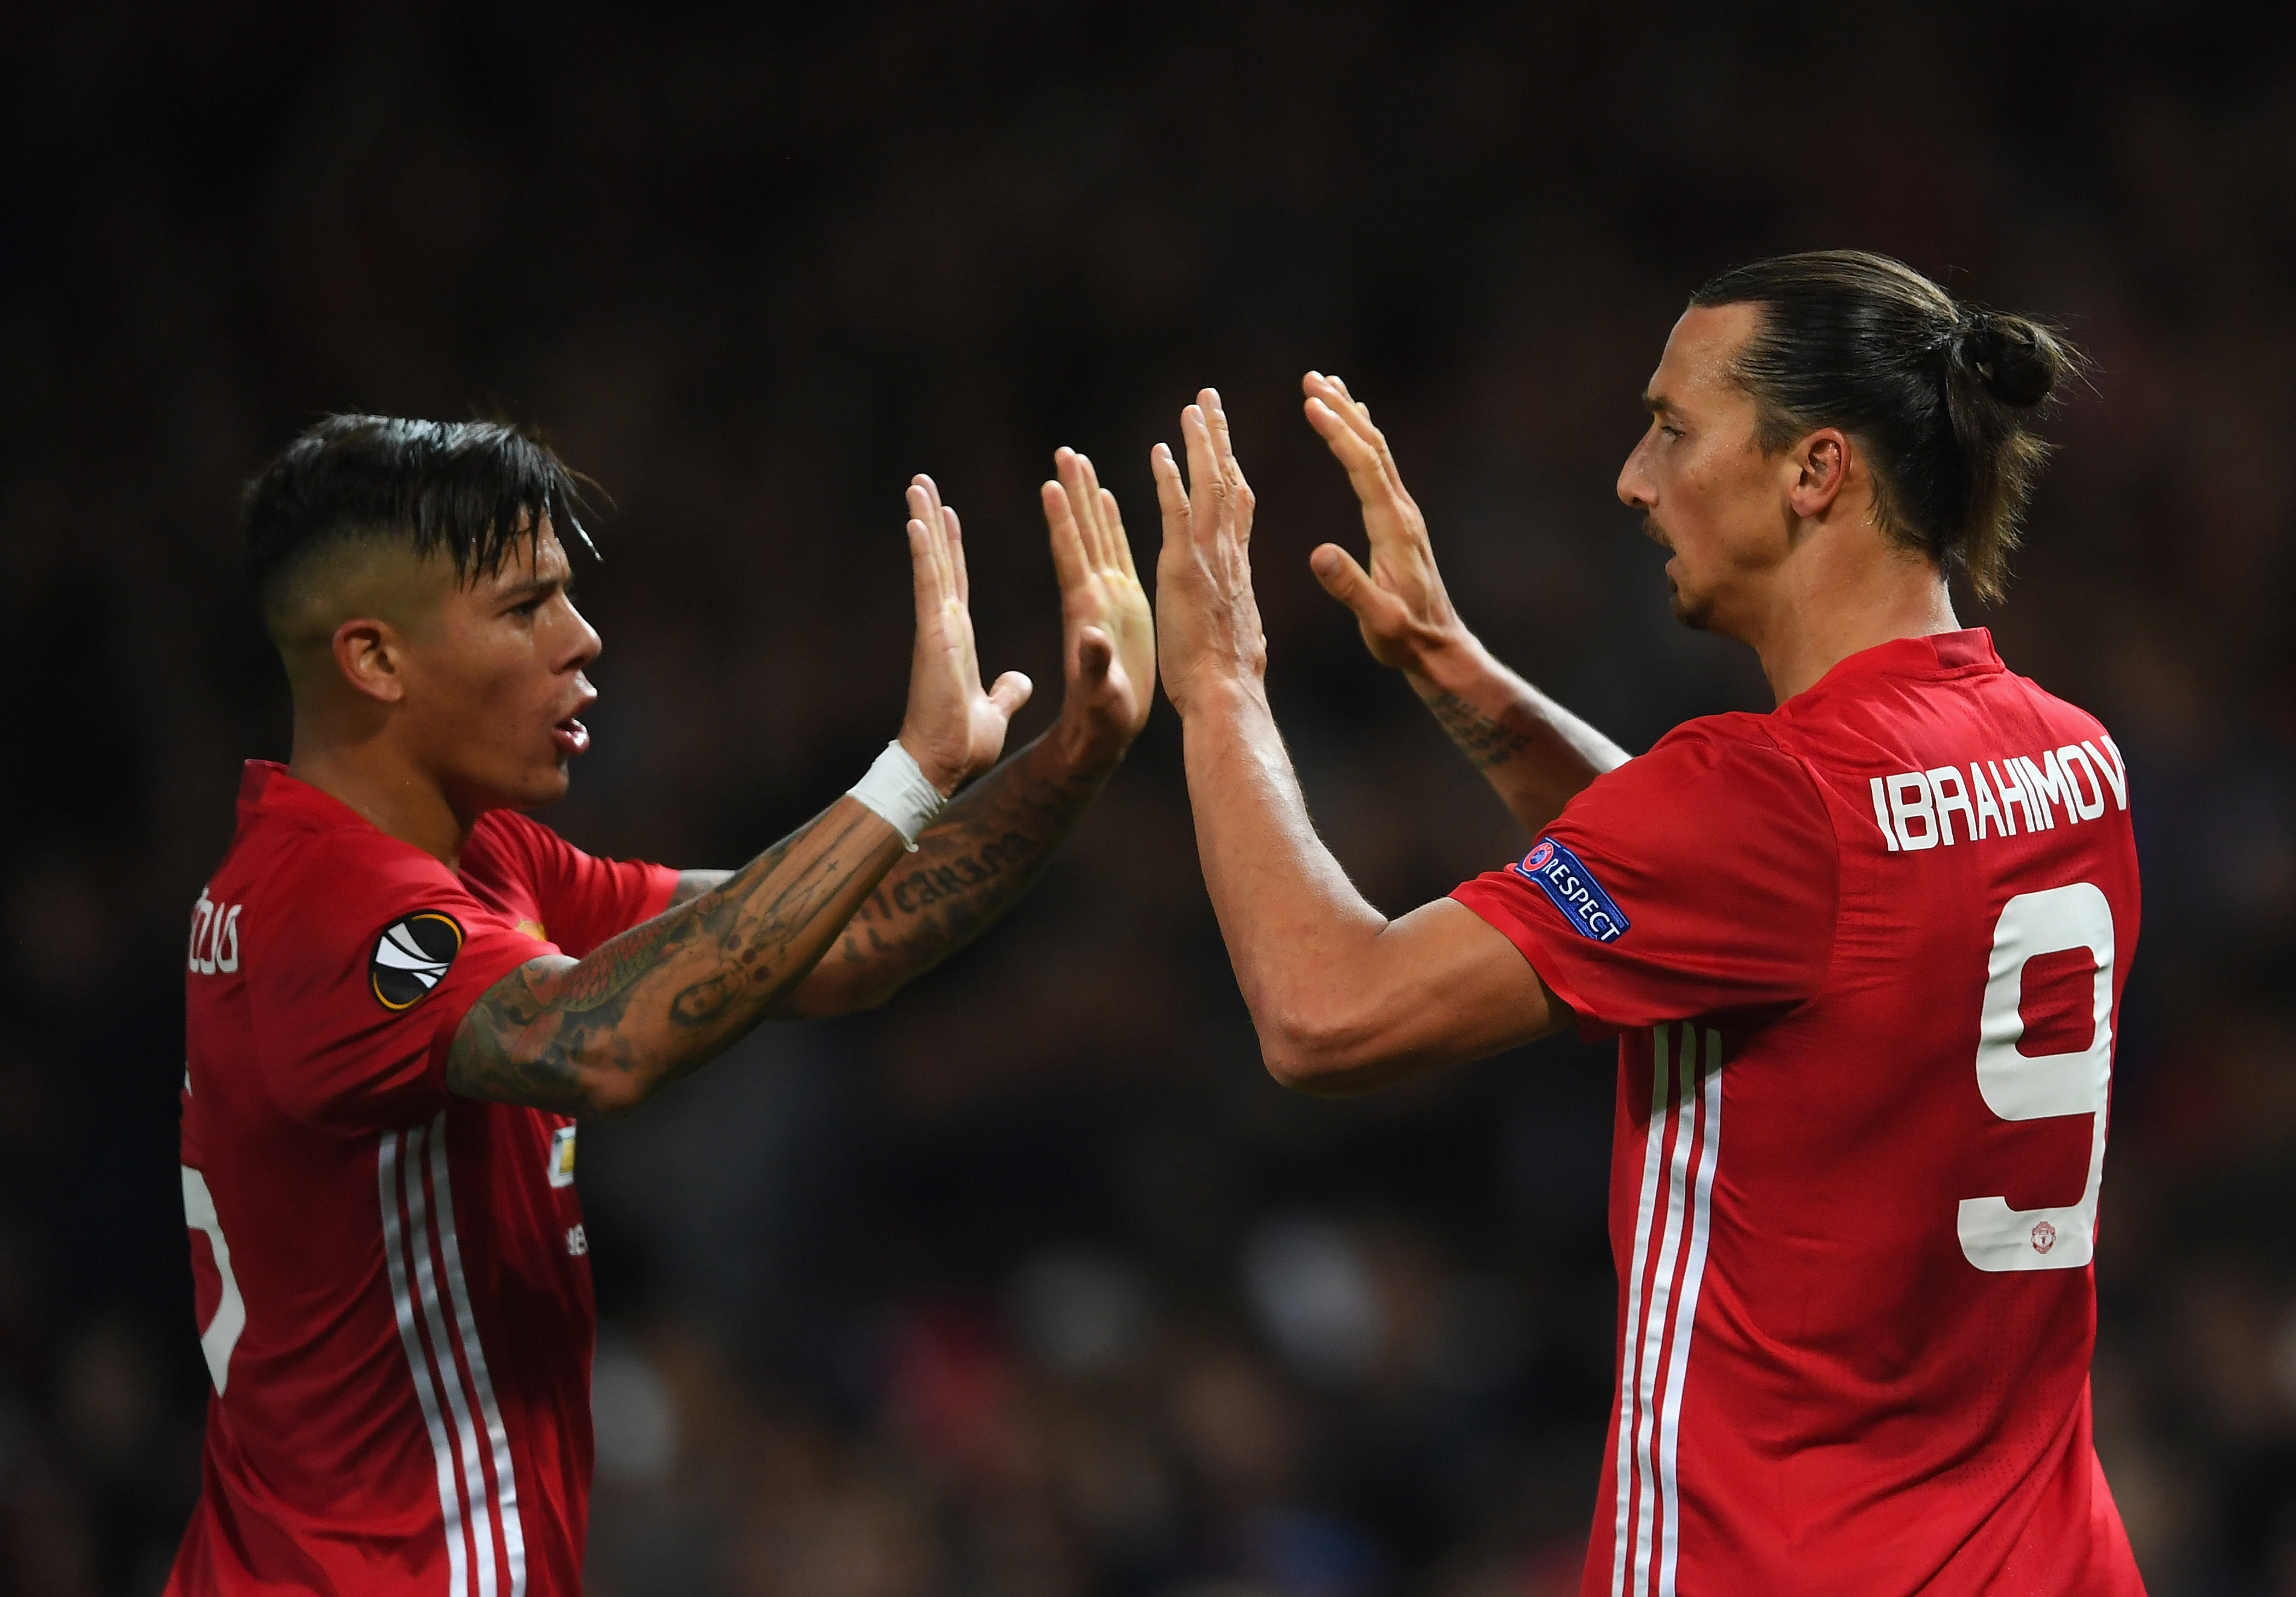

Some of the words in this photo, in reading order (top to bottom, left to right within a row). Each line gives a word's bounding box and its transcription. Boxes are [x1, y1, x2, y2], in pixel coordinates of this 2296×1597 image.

[1869, 735, 2127, 851] IBRAHIMOV
[1541, 858, 1620, 941] RESPECT
[1957, 882, 2115, 1272] 9
